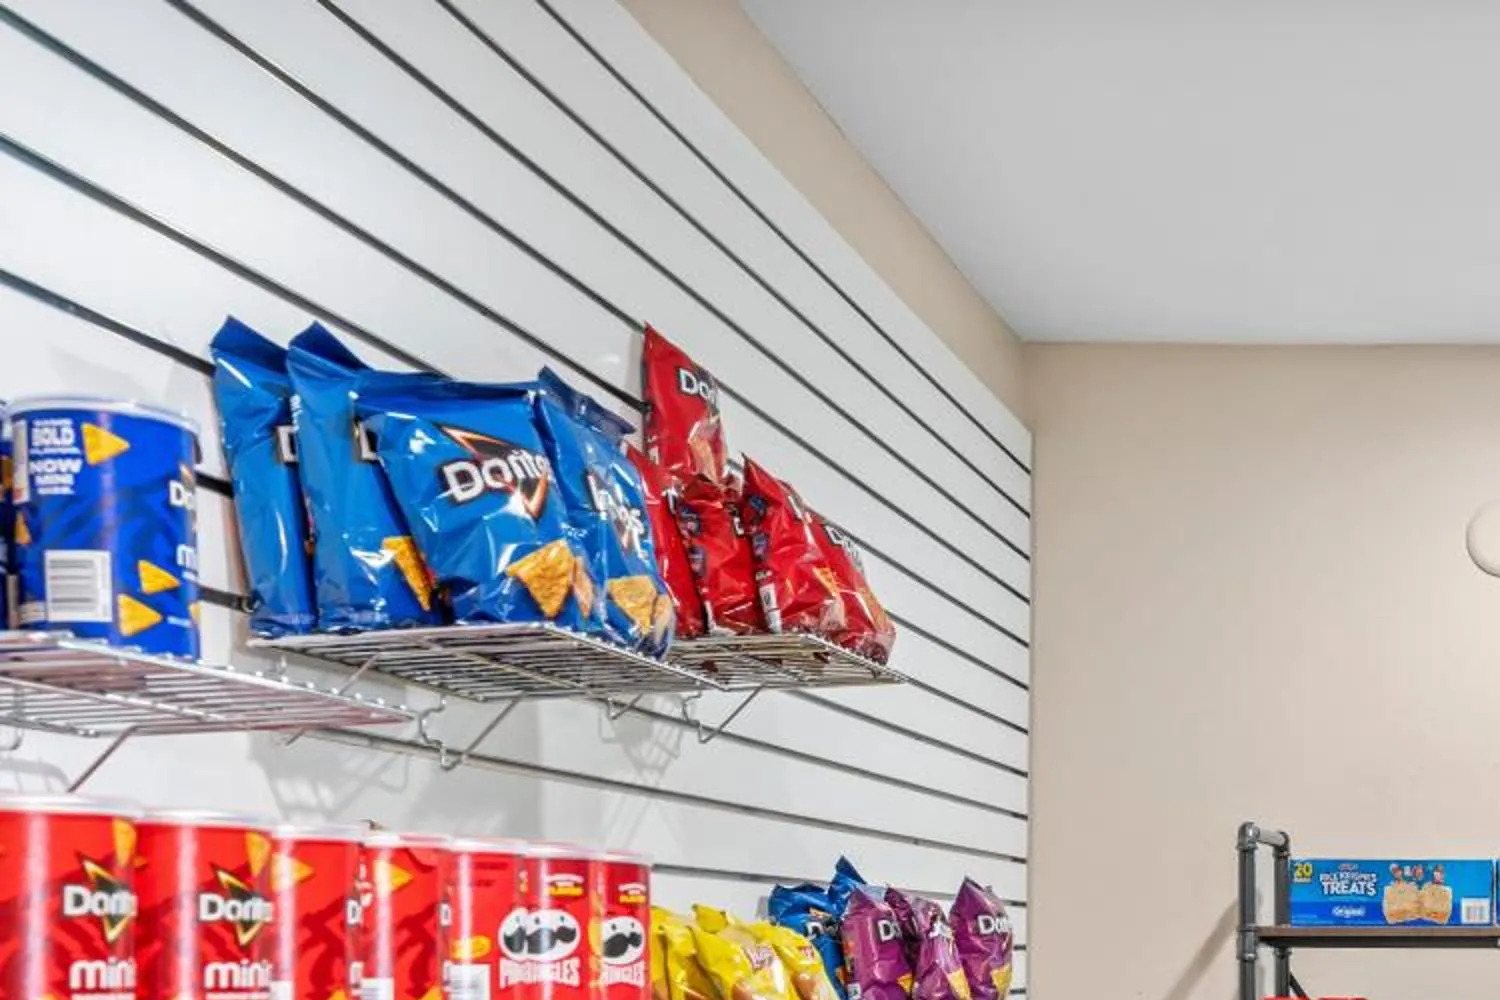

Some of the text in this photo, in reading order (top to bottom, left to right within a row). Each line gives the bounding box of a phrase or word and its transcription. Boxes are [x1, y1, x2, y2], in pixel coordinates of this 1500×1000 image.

[29, 459, 82, 473] NOW
[1295, 863, 1312, 877] 20
[1322, 881, 1376, 896] TREATS
